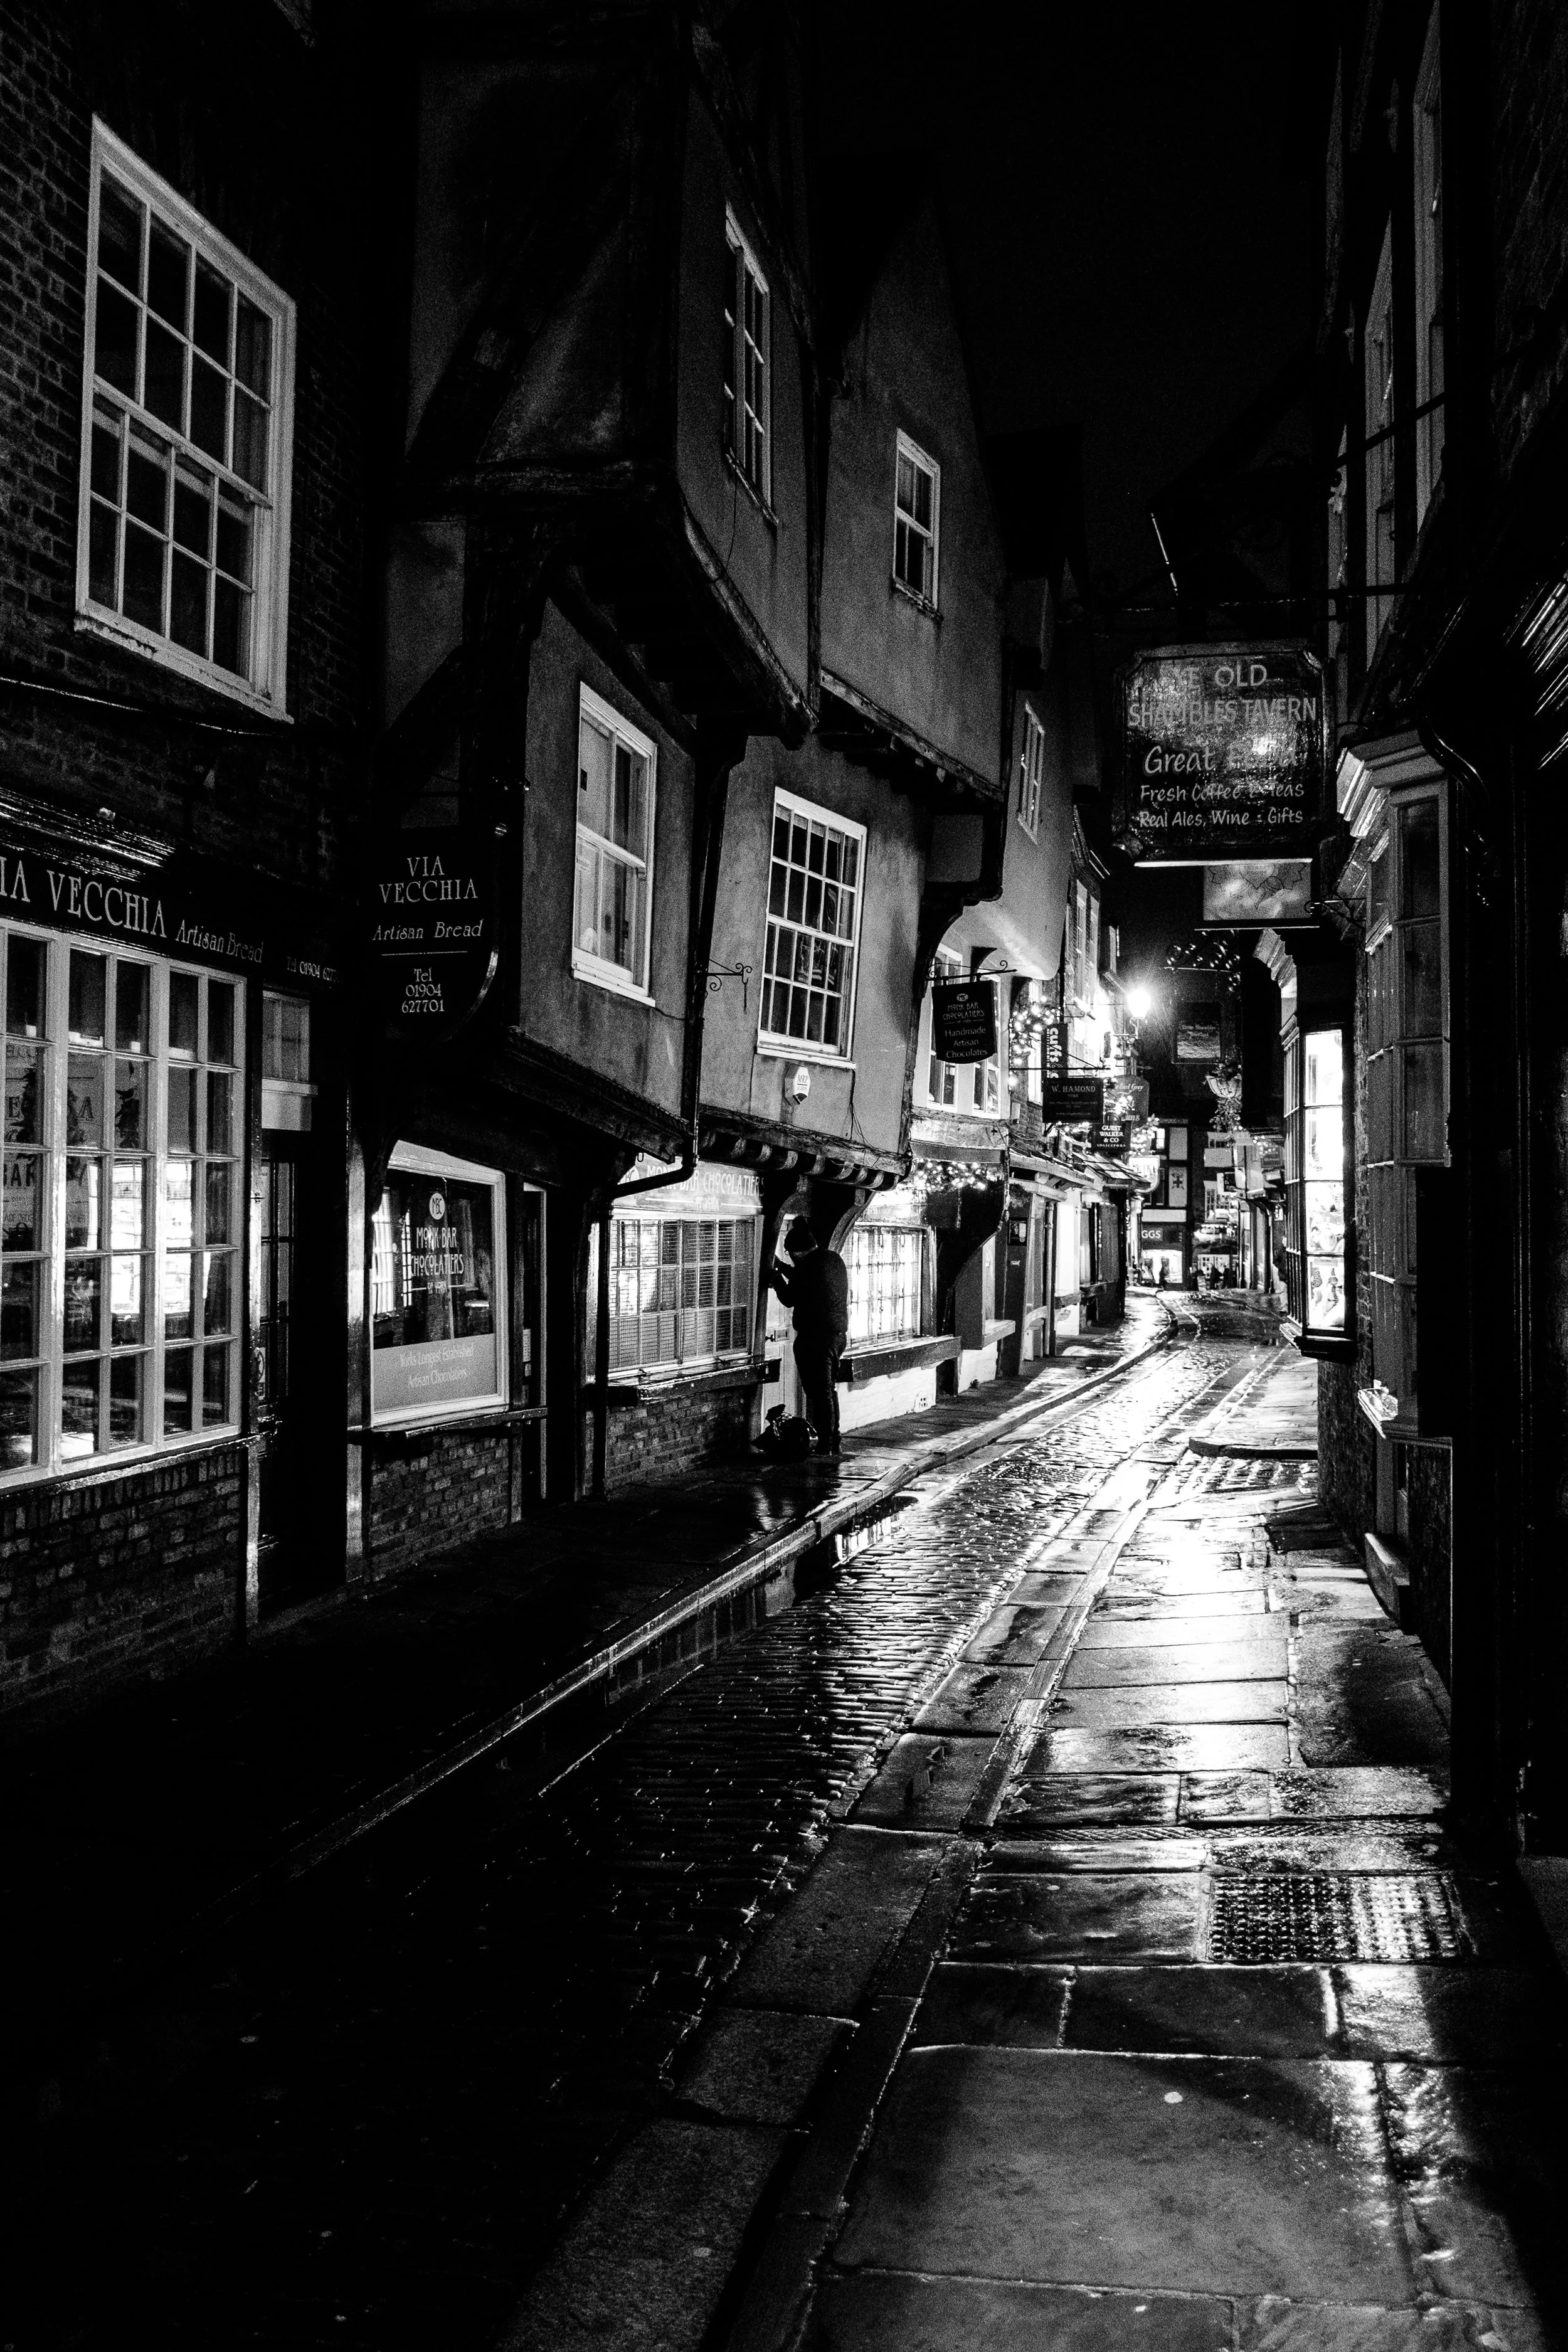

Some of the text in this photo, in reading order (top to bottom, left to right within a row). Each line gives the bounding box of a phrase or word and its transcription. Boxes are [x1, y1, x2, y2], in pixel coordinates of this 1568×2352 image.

[1214, 660, 1268, 687] OLD
[1128, 697, 1317, 728] SHAMBLES TAVERN
[1144, 745, 1216, 774] Great
[1140, 785, 1186, 802] Fresh
[1191, 783, 1241, 801] Coffee
[1139, 810, 1168, 827] Real
[1172, 810, 1207, 827] Ales,
[1212, 809, 1250, 825] Wine
[1268, 806, 1303, 824] Gifts
[407, 856, 445, 877] VIA
[379, 879, 478, 904] VECCHIA
[46, 869, 167, 938] VECCHIA
[175, 919, 225, 953] Artisan
[226, 933, 264, 964] Bread
[372, 918, 484, 940] Artisan Bread
[414, 968, 432, 982] Tel
[406, 983, 442, 997] 01904
[402, 1000, 445, 1013] 627701
[943, 1010, 985, 1020] CHOCOLATIERS
[967, 1002, 978, 1010] BAR
[945, 1026, 986, 1037] Handmade
[946, 1049, 987, 1058] Chocolates
[953, 1039, 979, 1047] Artisan
[703, 1171, 765, 1196] CHOCOLATIERS
[416, 1227, 457, 1248] MONK BAR
[411, 1254, 464, 1276] CHOCOLATIERS
